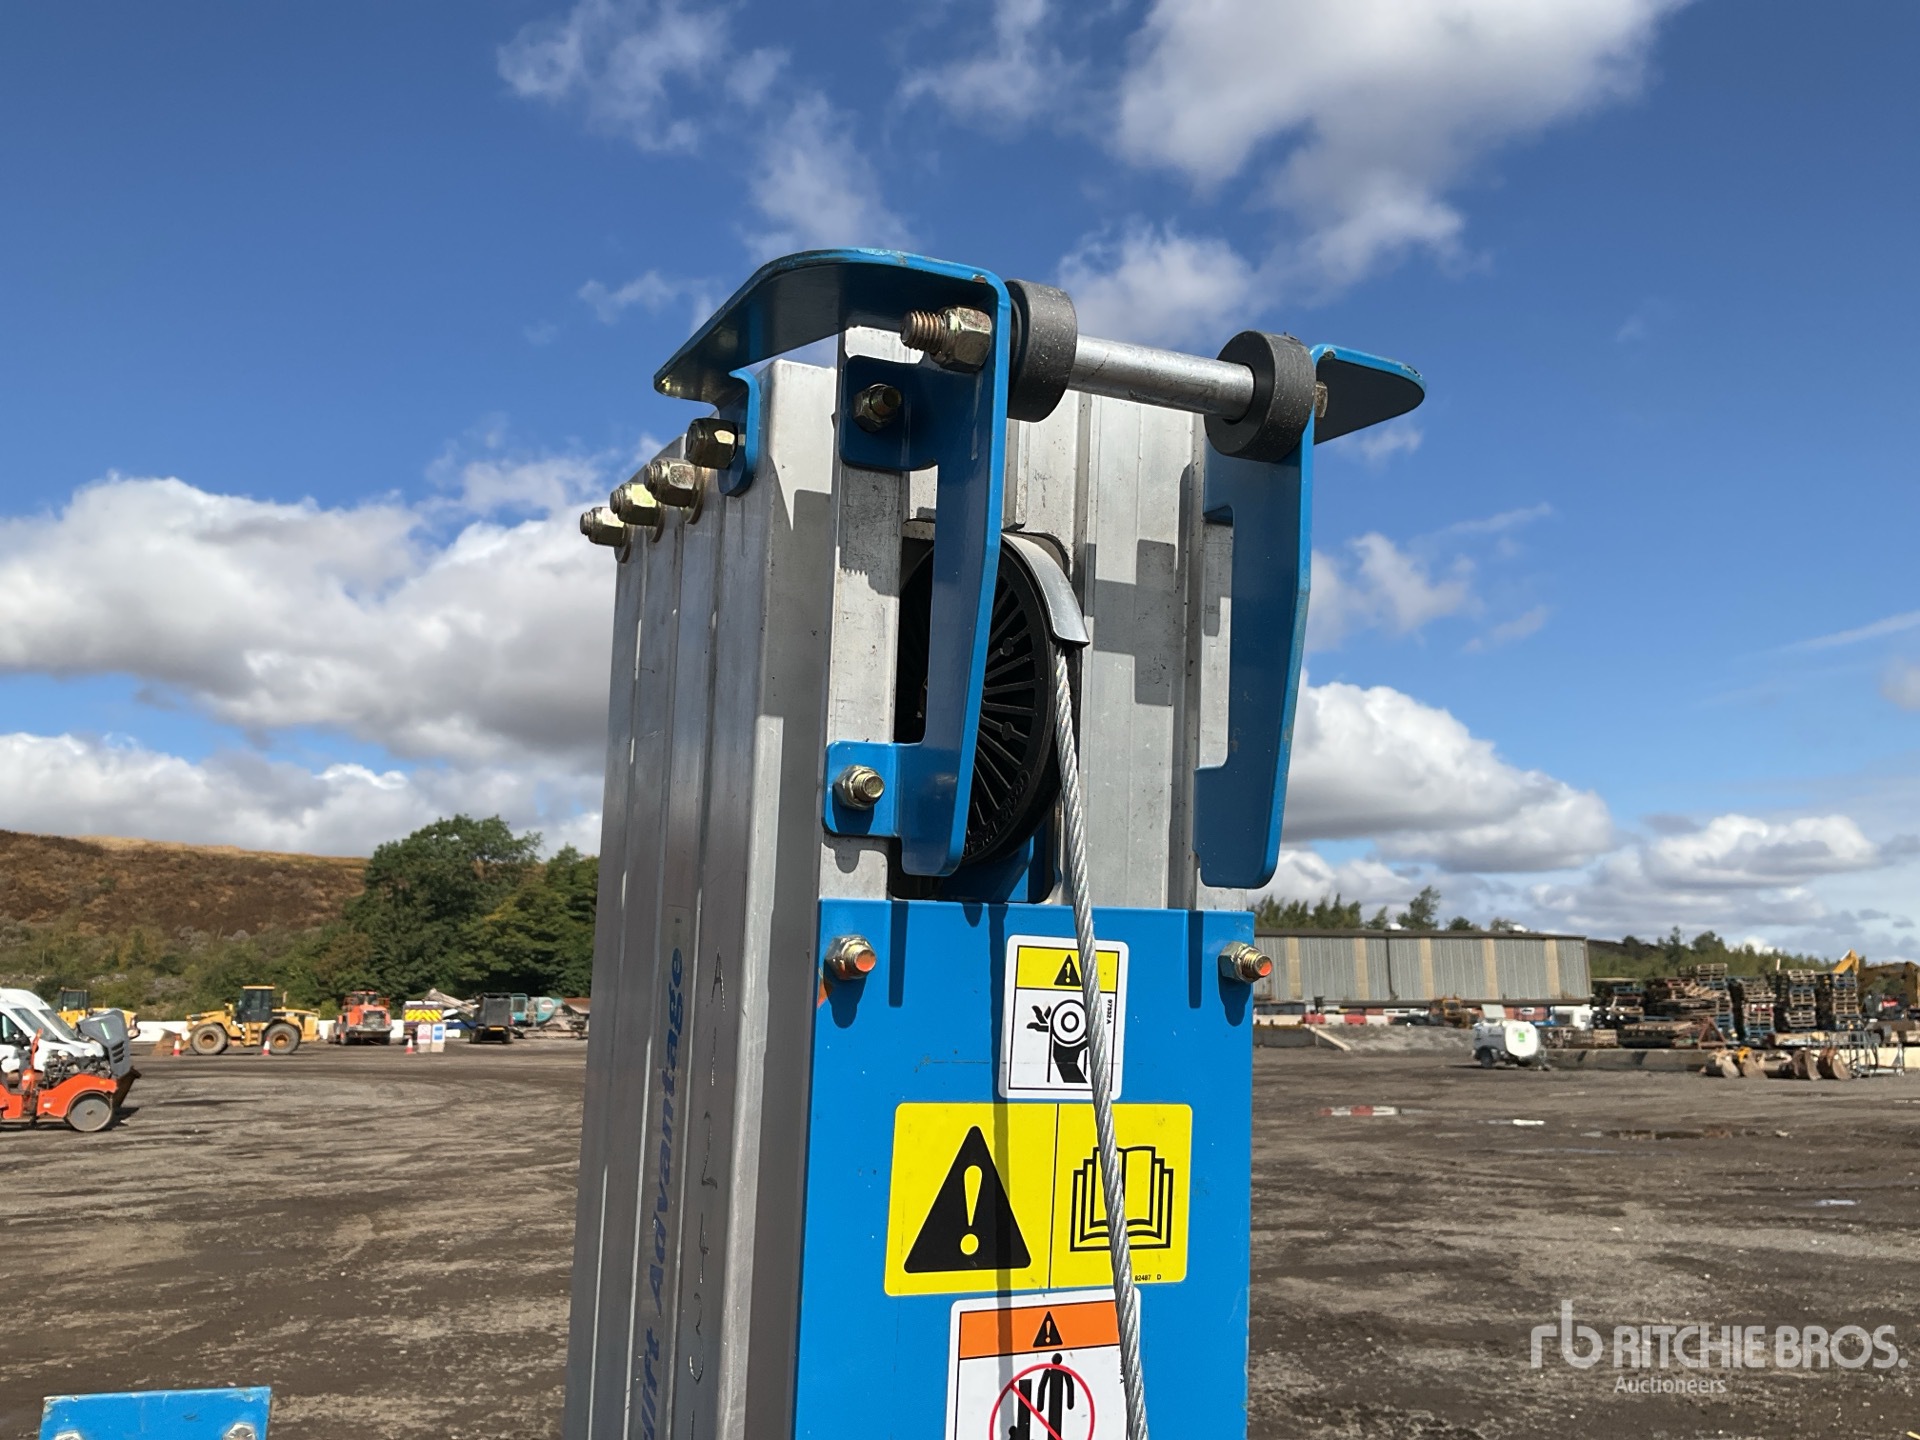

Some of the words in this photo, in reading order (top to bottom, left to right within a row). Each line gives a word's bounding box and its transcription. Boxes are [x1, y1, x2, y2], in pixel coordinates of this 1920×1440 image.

[649, 947, 683, 1317] Advantage
[1156, 1273, 1162, 1281] D
[641, 1326, 659, 1440] lift
